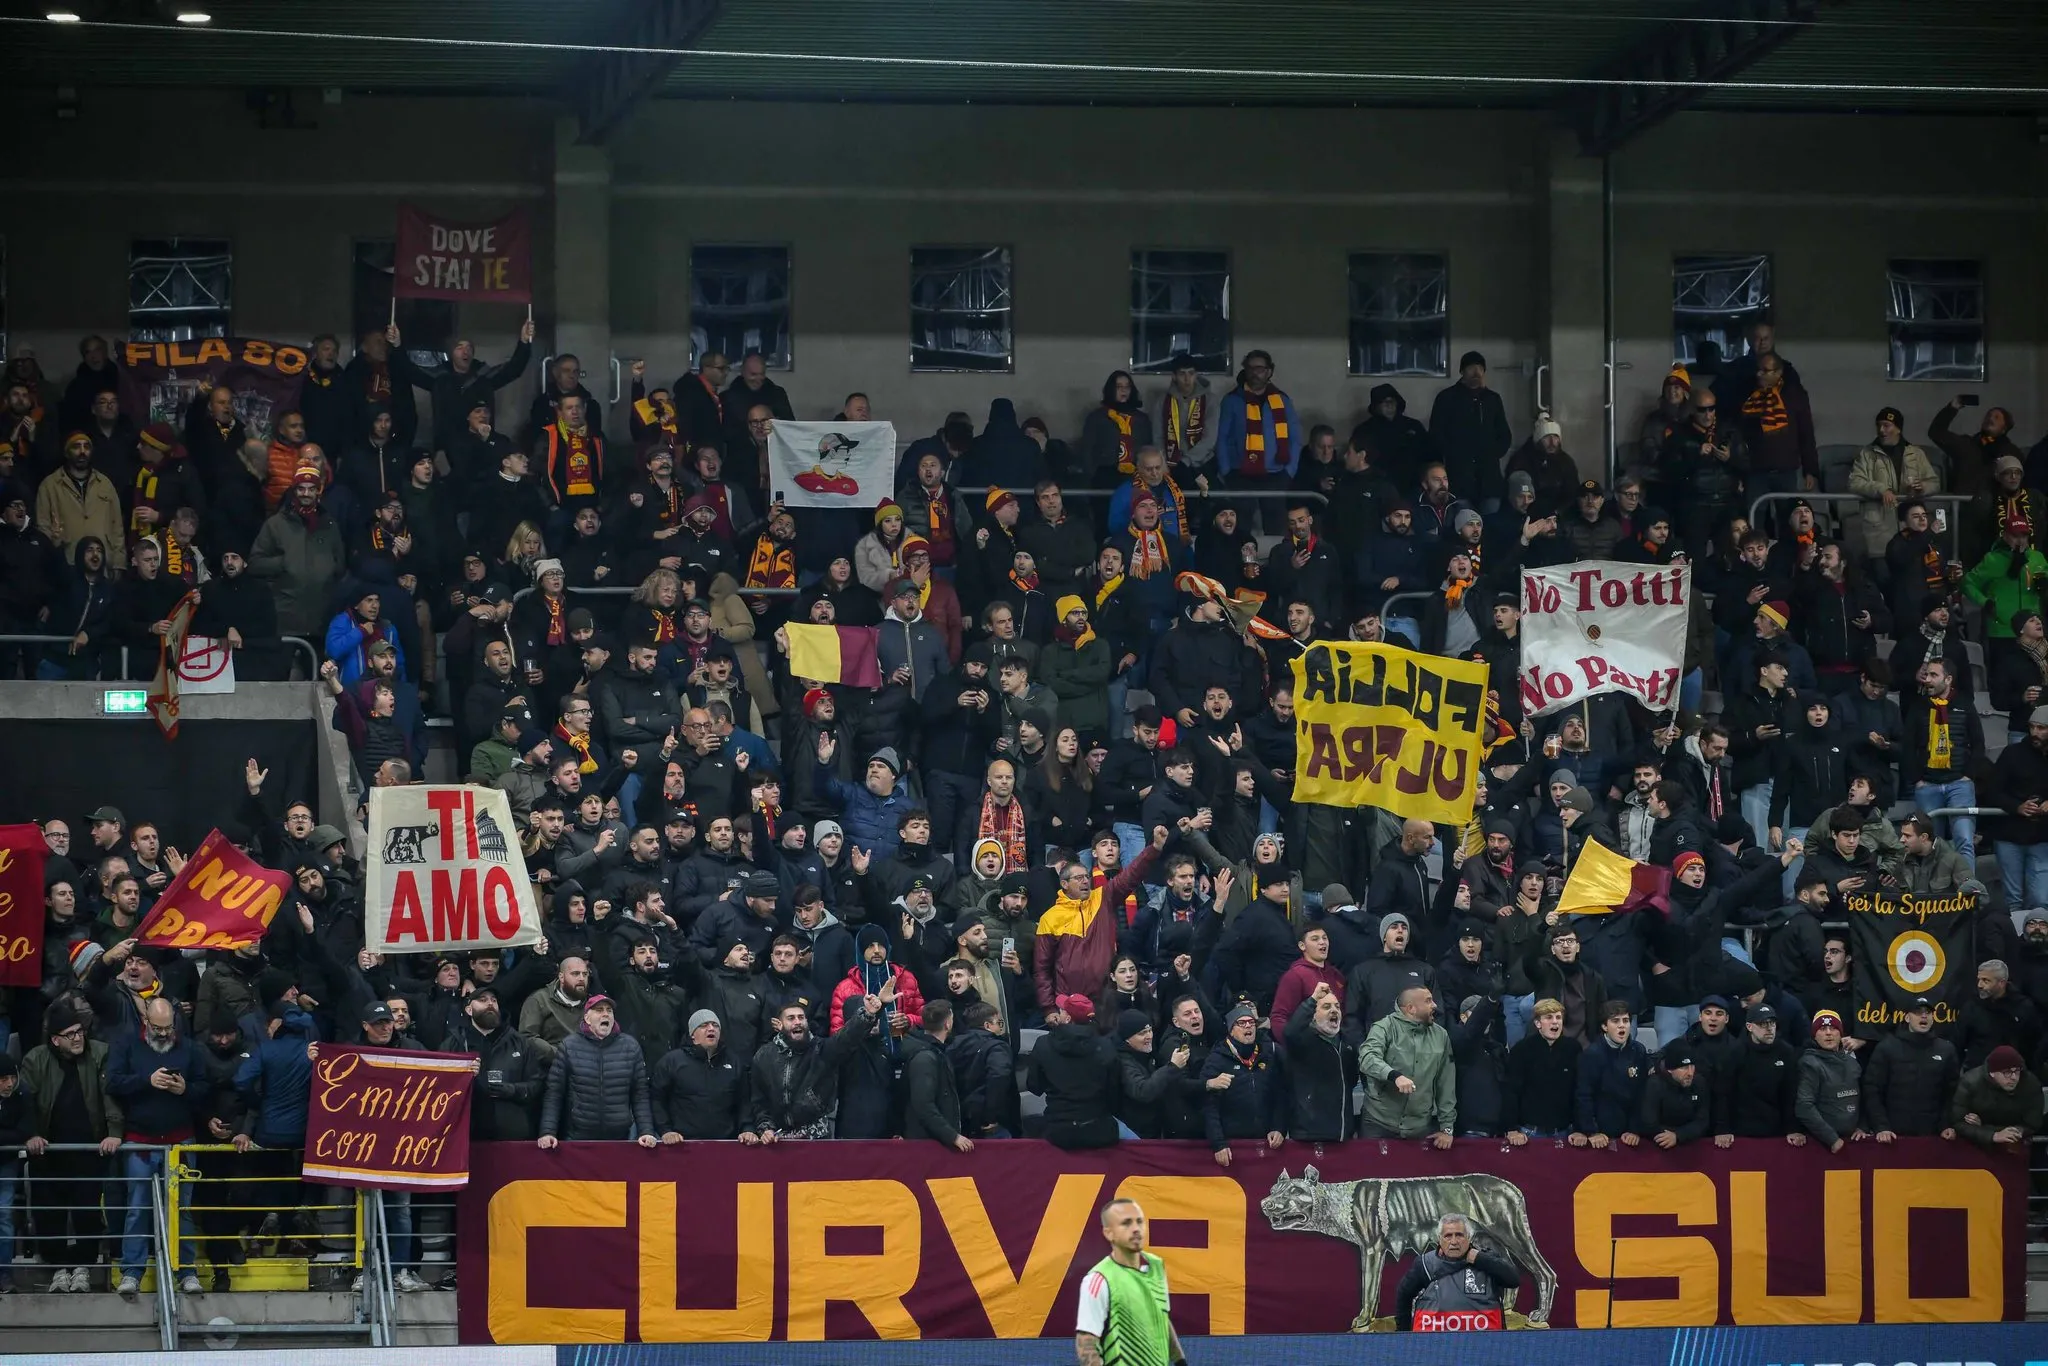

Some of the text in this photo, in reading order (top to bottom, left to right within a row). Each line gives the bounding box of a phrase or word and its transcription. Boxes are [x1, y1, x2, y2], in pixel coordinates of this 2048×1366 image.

[429, 224, 497, 253] DOVE
[414, 254, 510, 290] STAI TE
[126, 338, 308, 375] FILA 80
[1522, 569, 1684, 614] No Totti
[1520, 665, 1573, 715] No
[427, 791, 480, 860] TI
[385, 866, 521, 943] AMO
[1875, 893, 1896, 914] la
[1857, 1001, 1890, 1024] del
[317, 1052, 462, 1122] Emilio
[316, 1123, 452, 1168] con noi
[487, 1169, 2003, 1345] CURVA SUD
[1421, 1315, 1489, 1332] PHOTO
